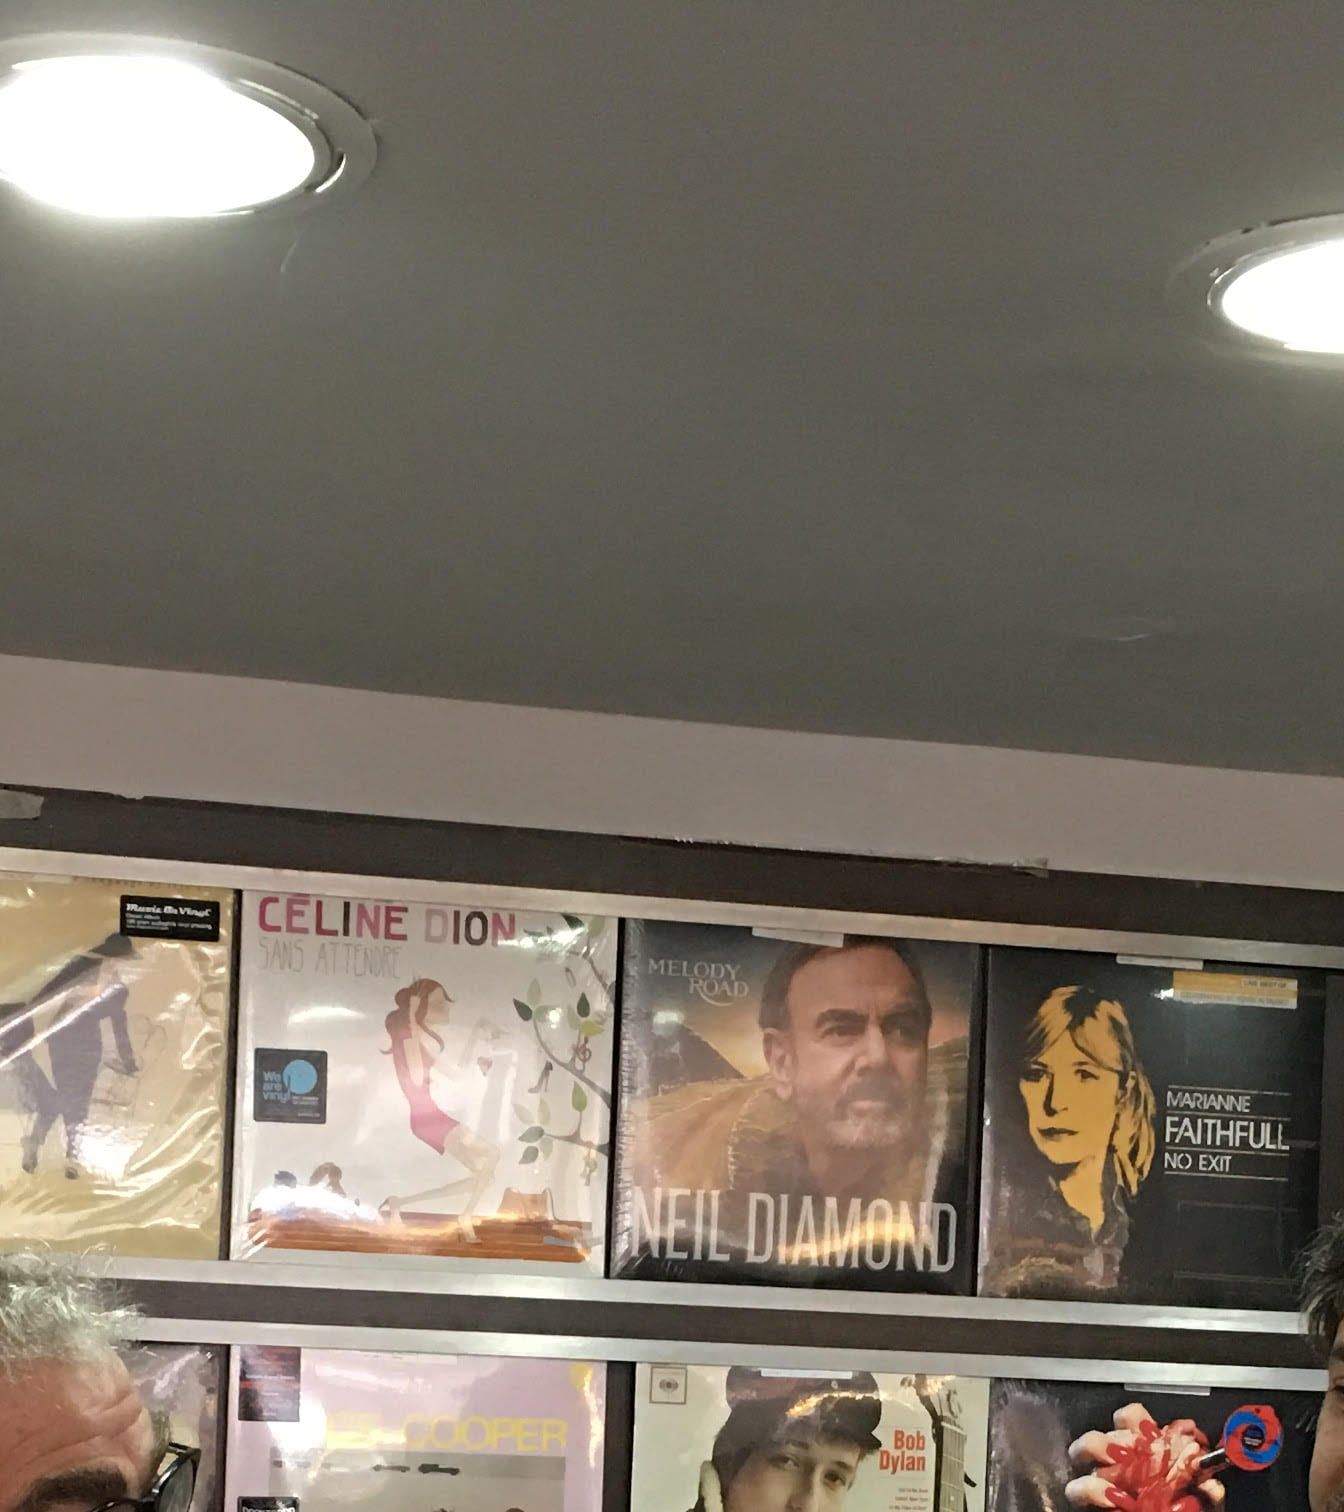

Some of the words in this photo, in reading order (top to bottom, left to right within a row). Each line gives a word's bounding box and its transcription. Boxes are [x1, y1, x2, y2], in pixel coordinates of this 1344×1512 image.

[425, 907, 516, 946] DION
[648, 958, 742, 981] MELODY
[689, 976, 749, 1006] ROAD
[1166, 1090, 1251, 1113] MARIANNE
[1165, 1115, 1290, 1151] FAITHFULL
[1164, 1152, 1193, 1171] NO
[1198, 1154, 1233, 1173] EXIT
[631, 1185, 731, 1264] NEIL
[748, 1191, 958, 1275] DIAMOND
[405, 1414, 568, 1452] COOPER
[894, 1429, 926, 1451] Bob
[879, 1450, 927, 1475] Dylan
